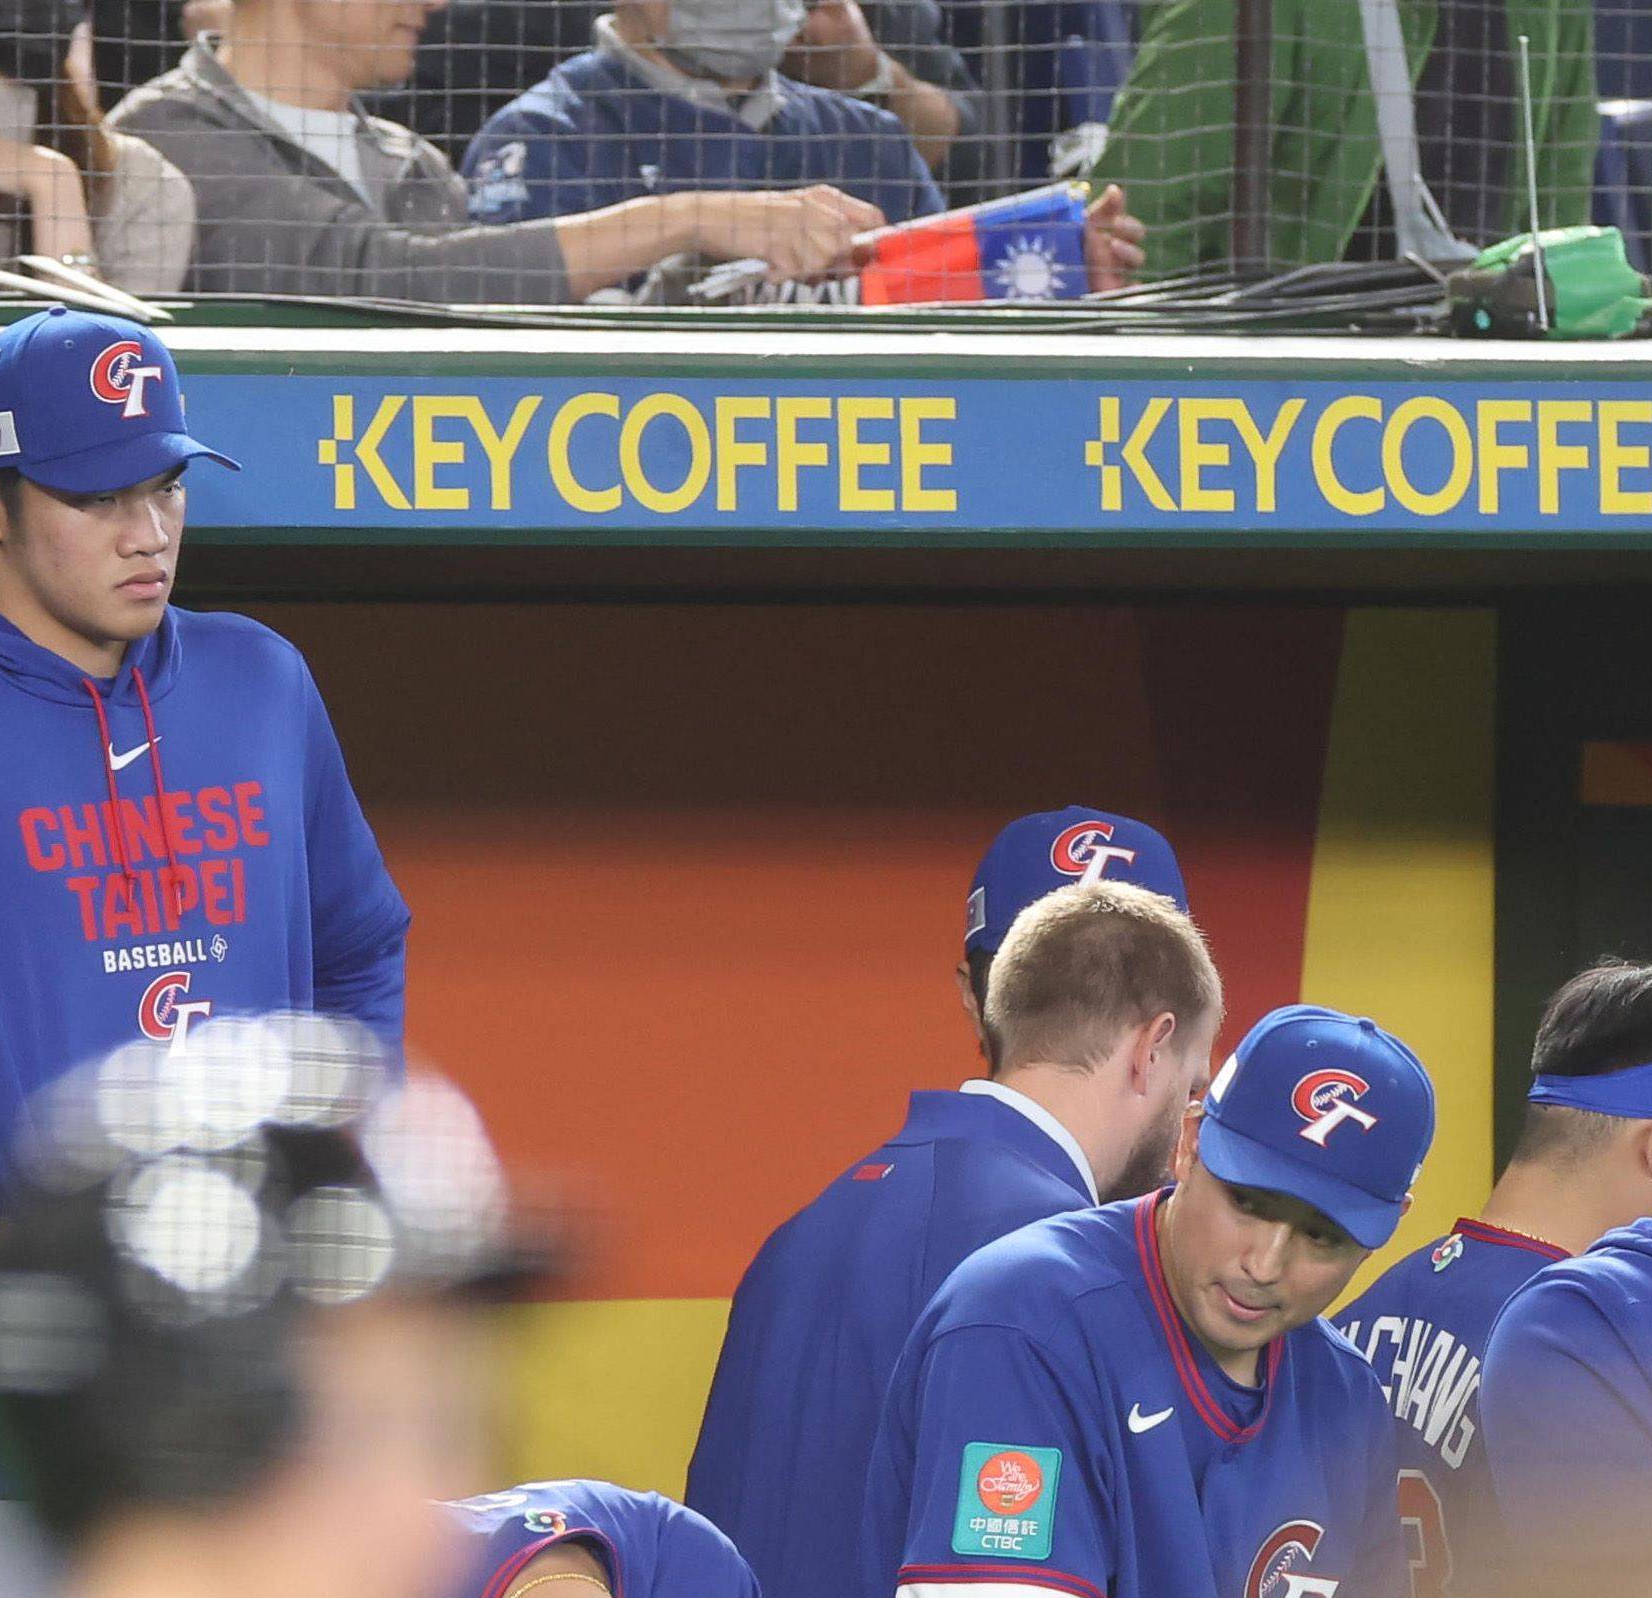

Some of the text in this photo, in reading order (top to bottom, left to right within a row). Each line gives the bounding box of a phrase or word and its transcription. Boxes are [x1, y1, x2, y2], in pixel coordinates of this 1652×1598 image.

[18, 780, 269, 873] CHINESE
[65, 859, 246, 941] TAIPEI
[103, 939, 206, 973] BASEBALL
[969, 1517, 1039, 1536] 中國信託
[981, 1534, 1023, 1551] CTBC
